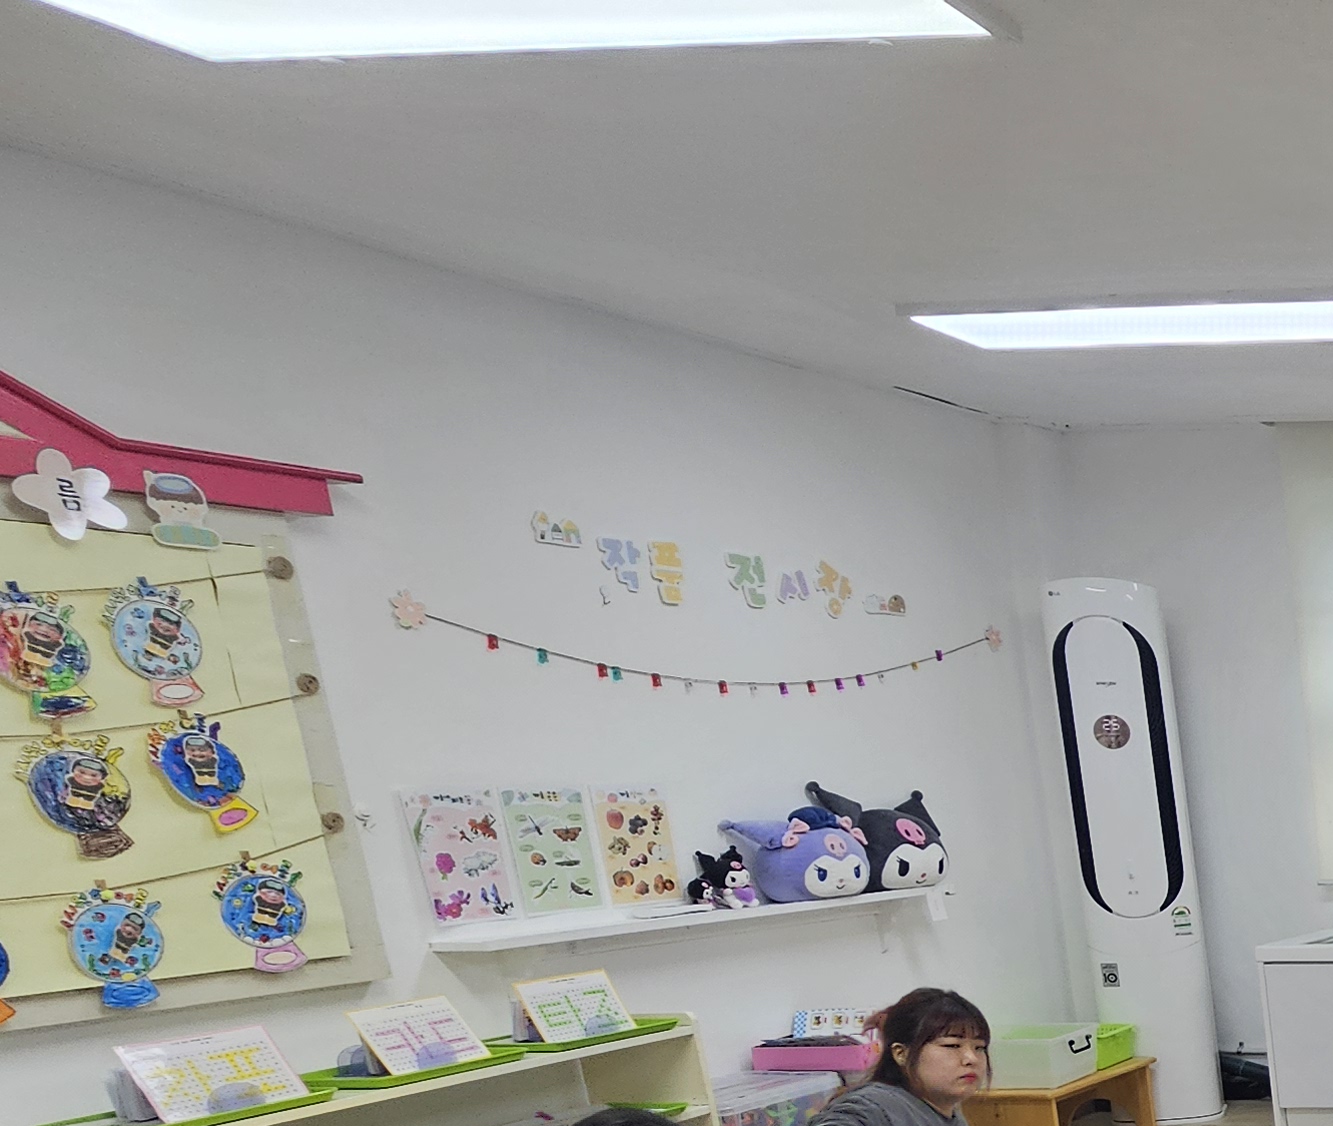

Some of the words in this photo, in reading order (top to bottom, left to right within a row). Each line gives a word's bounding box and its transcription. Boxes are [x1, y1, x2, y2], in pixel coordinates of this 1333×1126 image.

[600, 537, 684, 603] 작품
[727, 552, 853, 617] 전시장
[1102, 718, 1121, 732] 25
